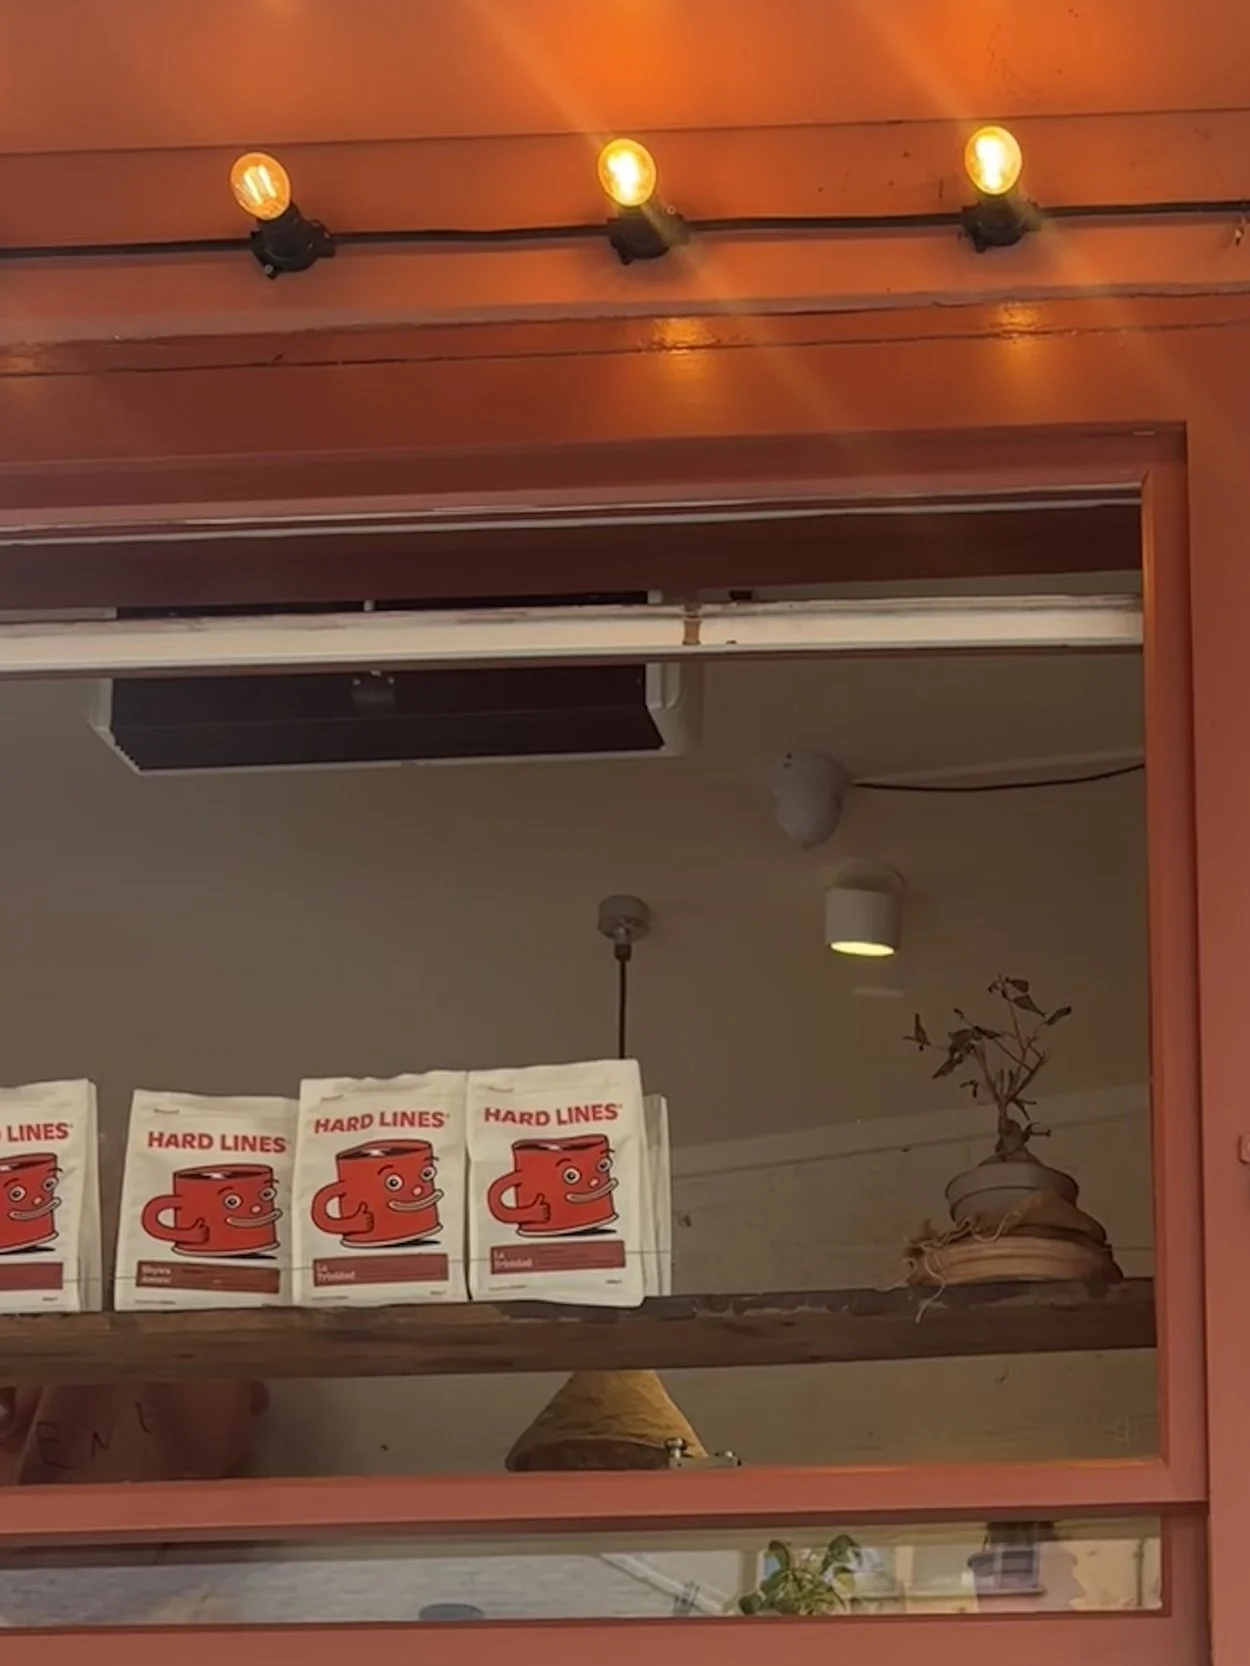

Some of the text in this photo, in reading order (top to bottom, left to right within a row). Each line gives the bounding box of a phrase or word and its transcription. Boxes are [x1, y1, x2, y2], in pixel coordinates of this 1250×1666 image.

[314, 1111, 444, 1134] HARD LINES
[484, 1103, 618, 1126] HARD LINES
[7, 1122, 69, 1142] LINES
[148, 1131, 287, 1153] HARD LINES
